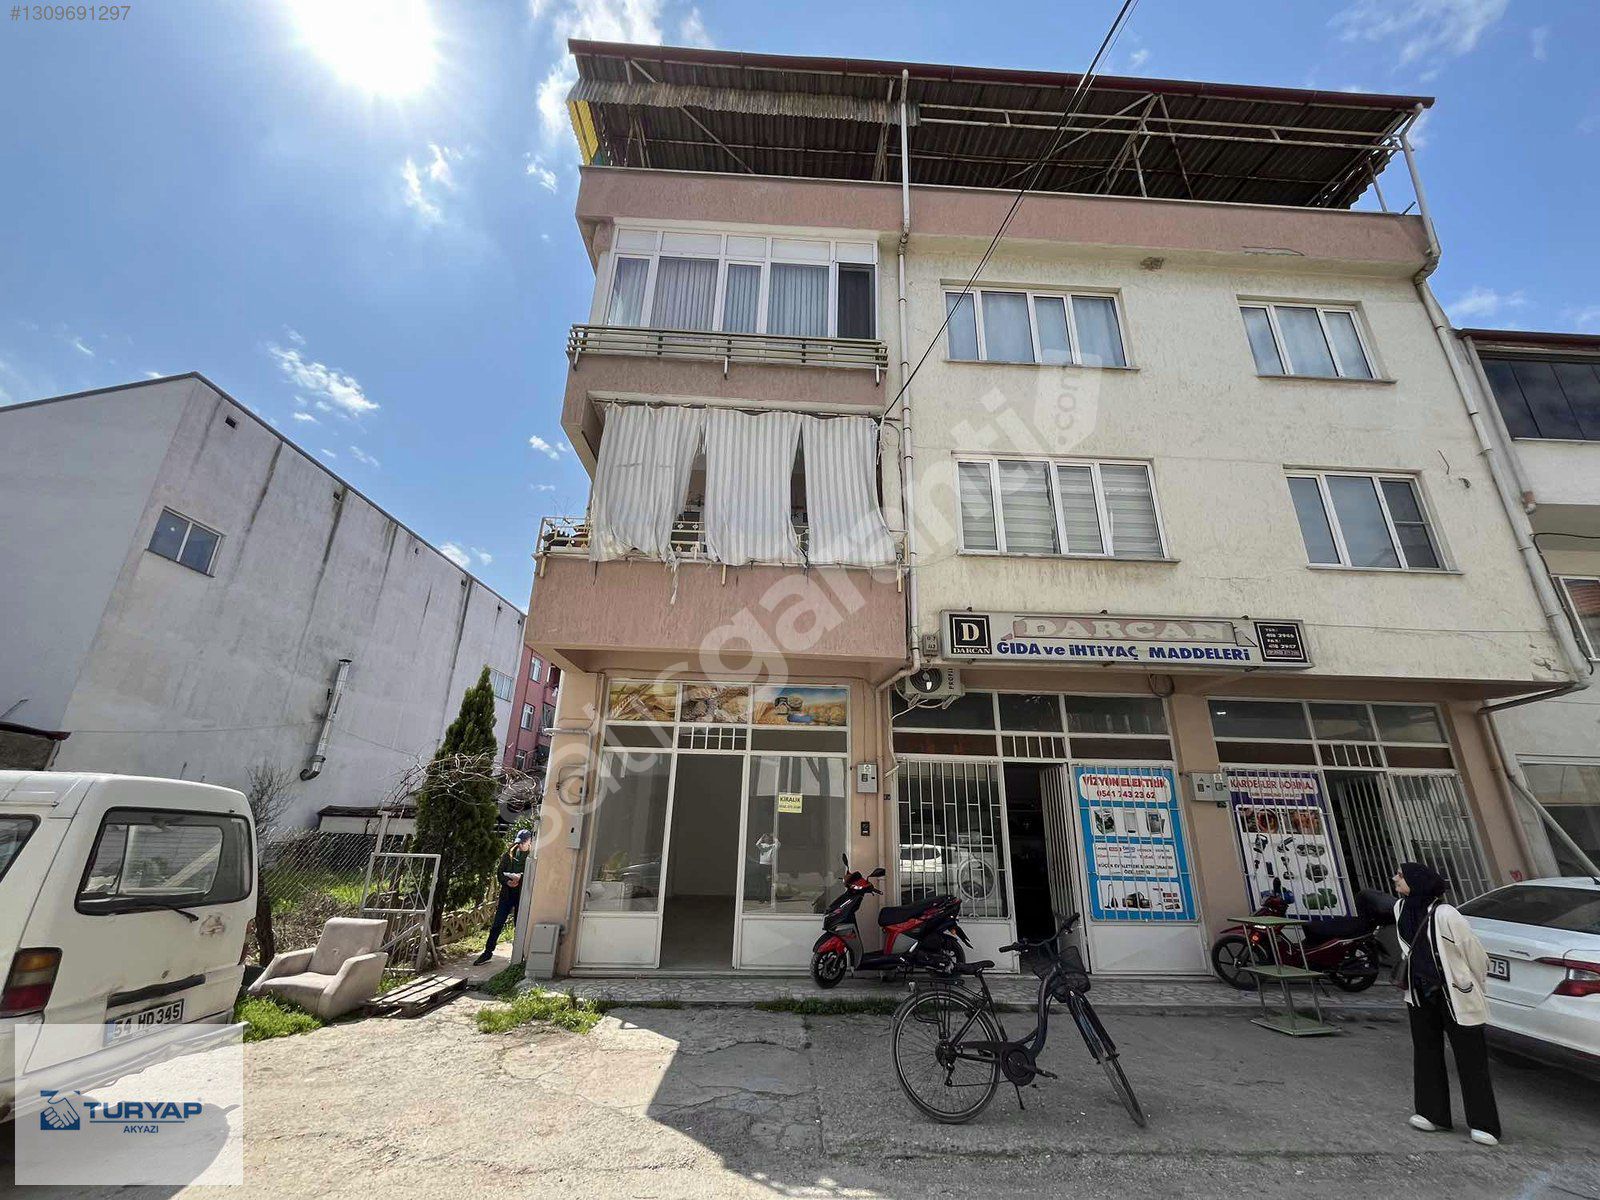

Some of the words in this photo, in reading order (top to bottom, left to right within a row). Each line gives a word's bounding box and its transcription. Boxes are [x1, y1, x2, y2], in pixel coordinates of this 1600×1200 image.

[960, 622, 980, 641] D
[953, 646, 991, 655] DARCAN
[996, 642, 1042, 655] GIDA
[1043, 645, 1066, 656] ve
[155, 1003, 181, 1025] 345
